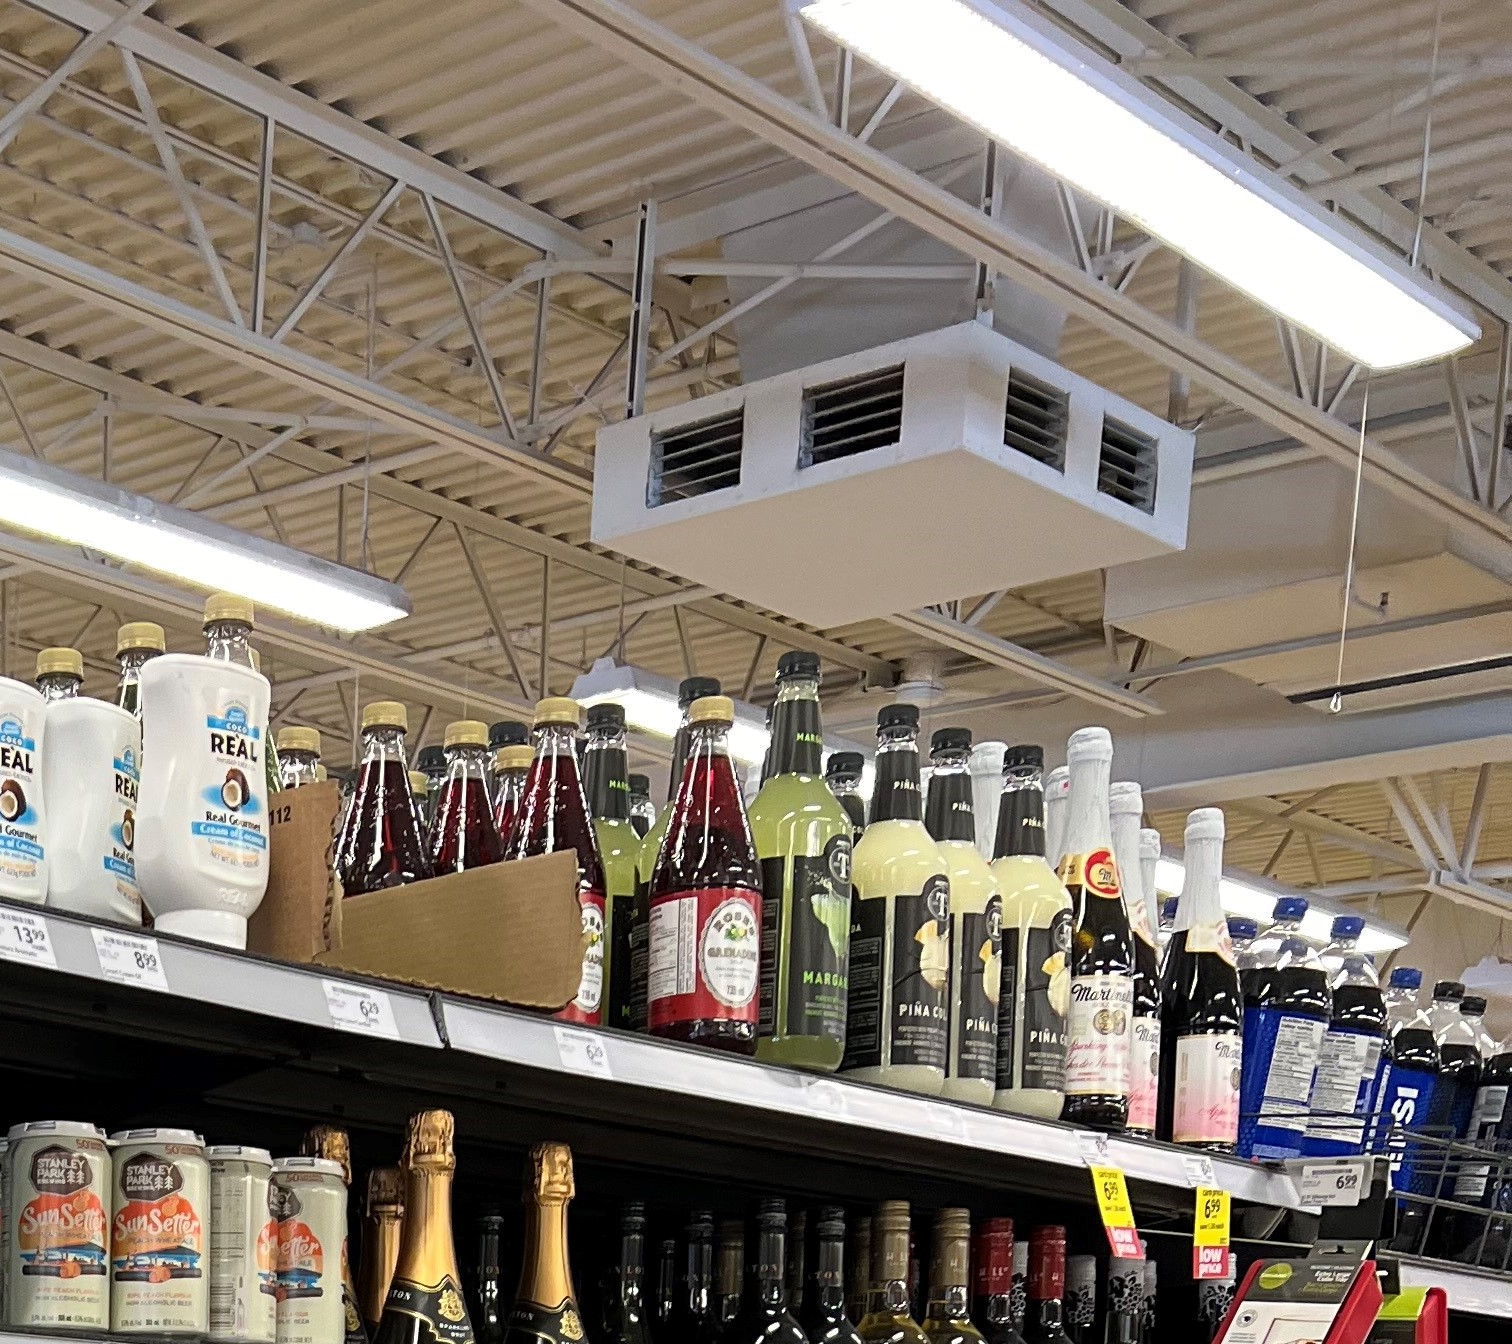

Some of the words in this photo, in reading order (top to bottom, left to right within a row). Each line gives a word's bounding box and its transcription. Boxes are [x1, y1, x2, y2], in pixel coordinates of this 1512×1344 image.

[4, 826, 39, 844] Gourmet
[898, 1002, 931, 1018] PIÑA
[37, 1157, 85, 1172] STANLEY
[126, 1163, 175, 1179] STANLEY
[22, 1202, 106, 1237] SunSetter
[114, 1208, 201, 1243] SunSetter
